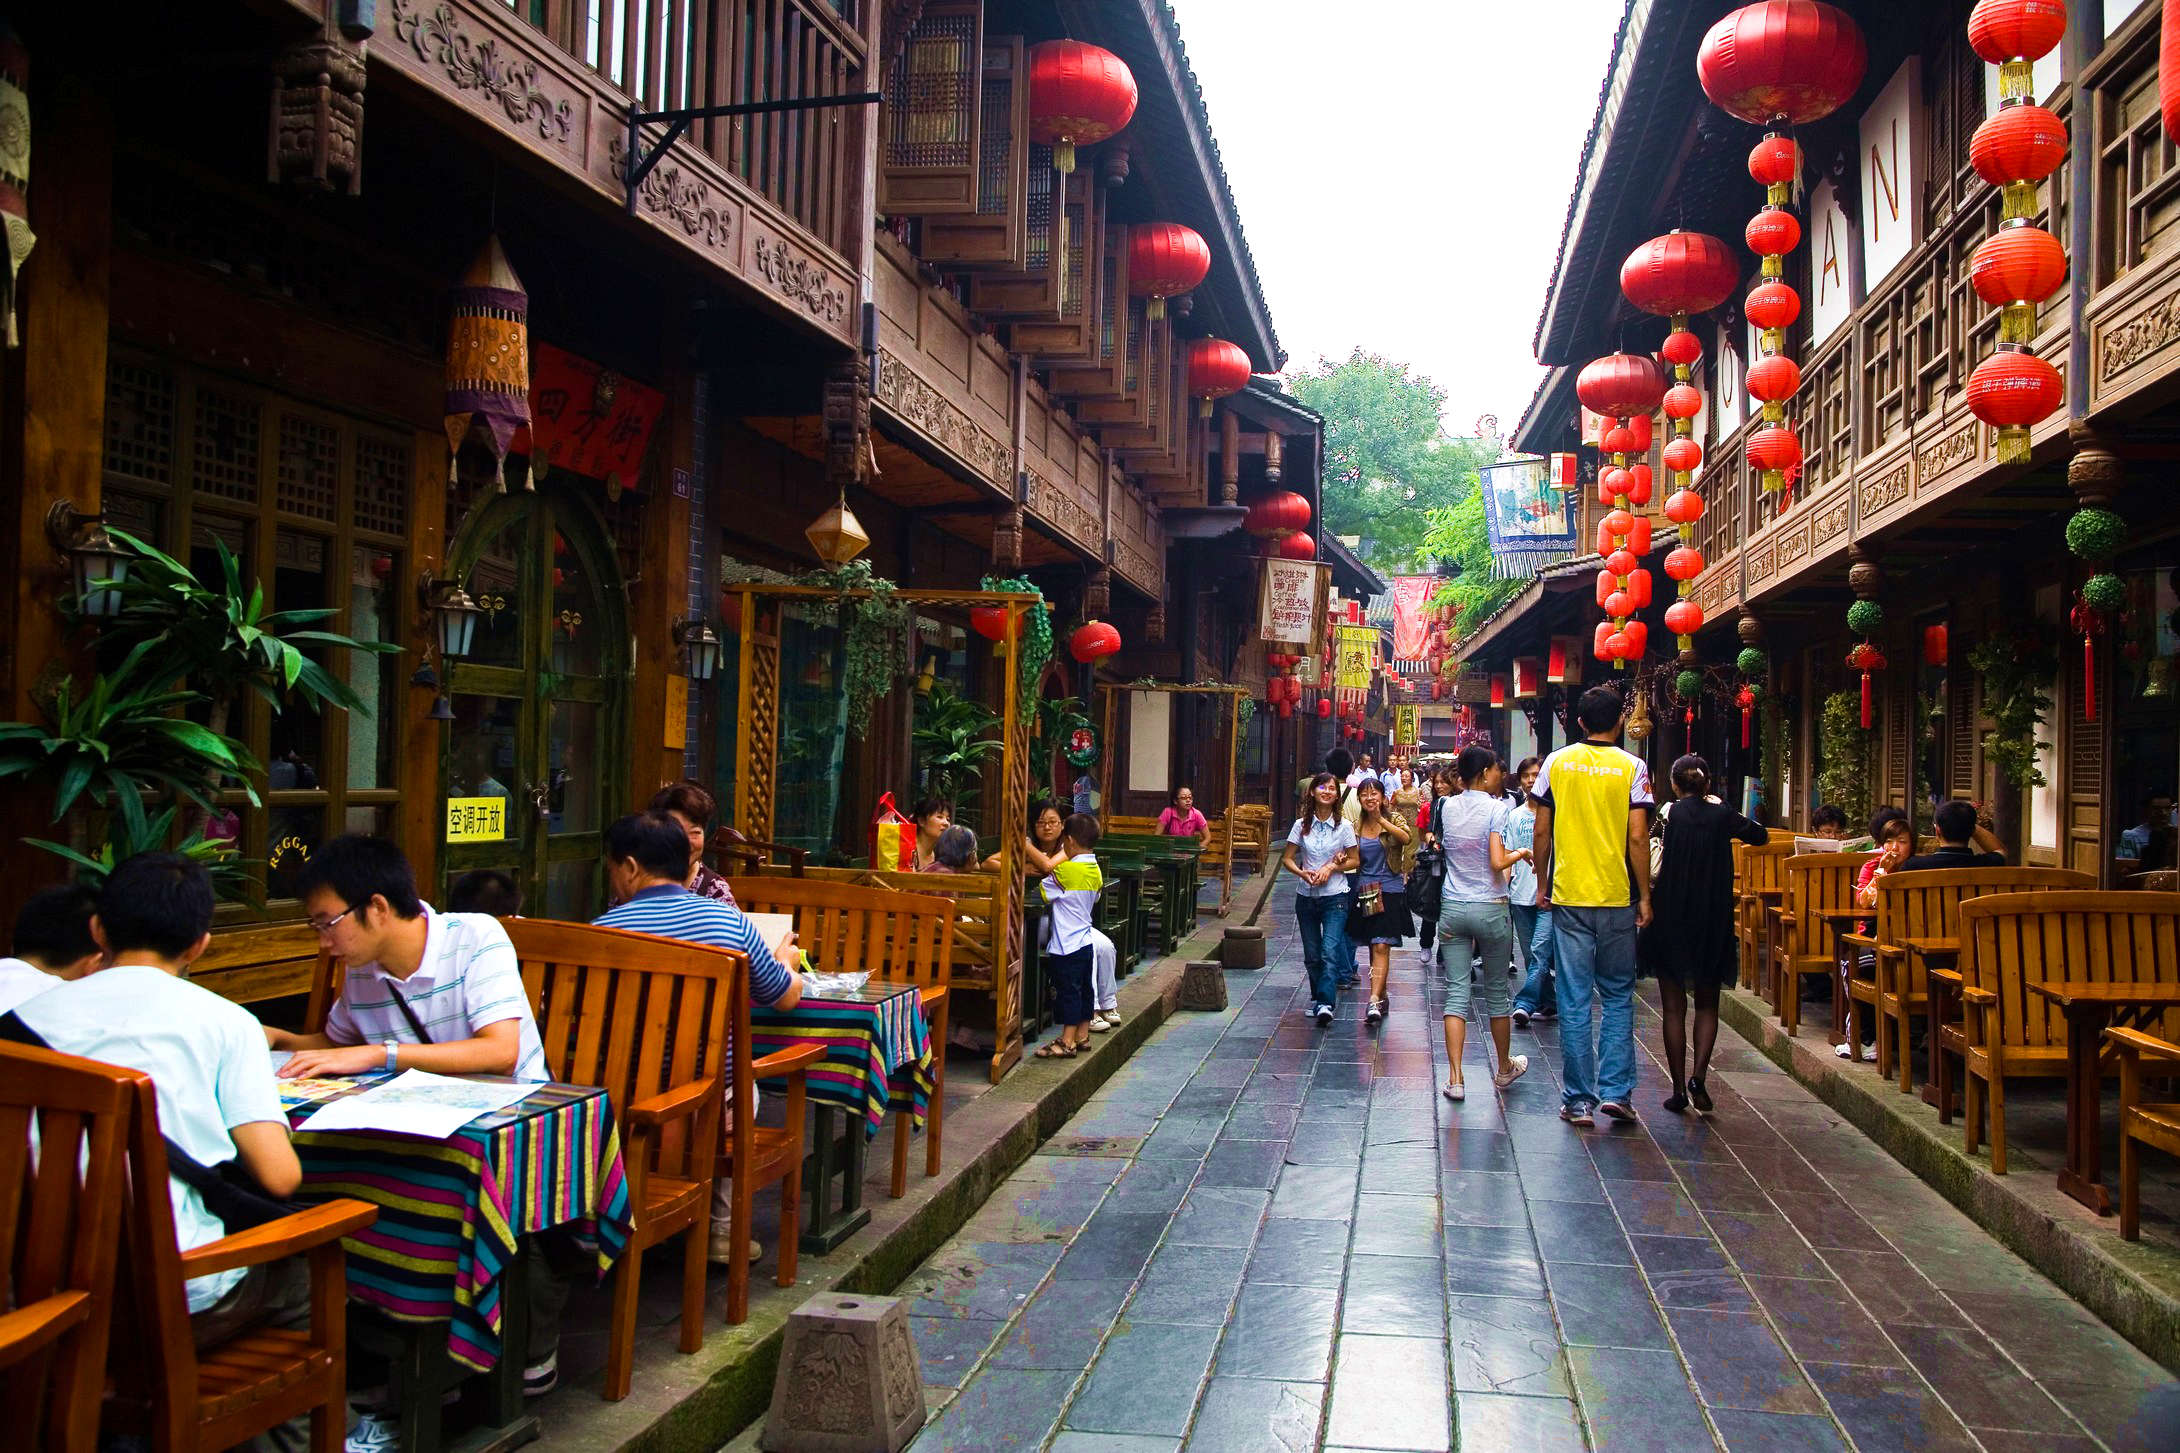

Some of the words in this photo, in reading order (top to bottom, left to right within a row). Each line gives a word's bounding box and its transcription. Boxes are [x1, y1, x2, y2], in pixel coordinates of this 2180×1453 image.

[1871, 118, 1899, 243] N
[1563, 762, 1623, 777] Kappa
[450, 805, 500, 834] 空调开放
